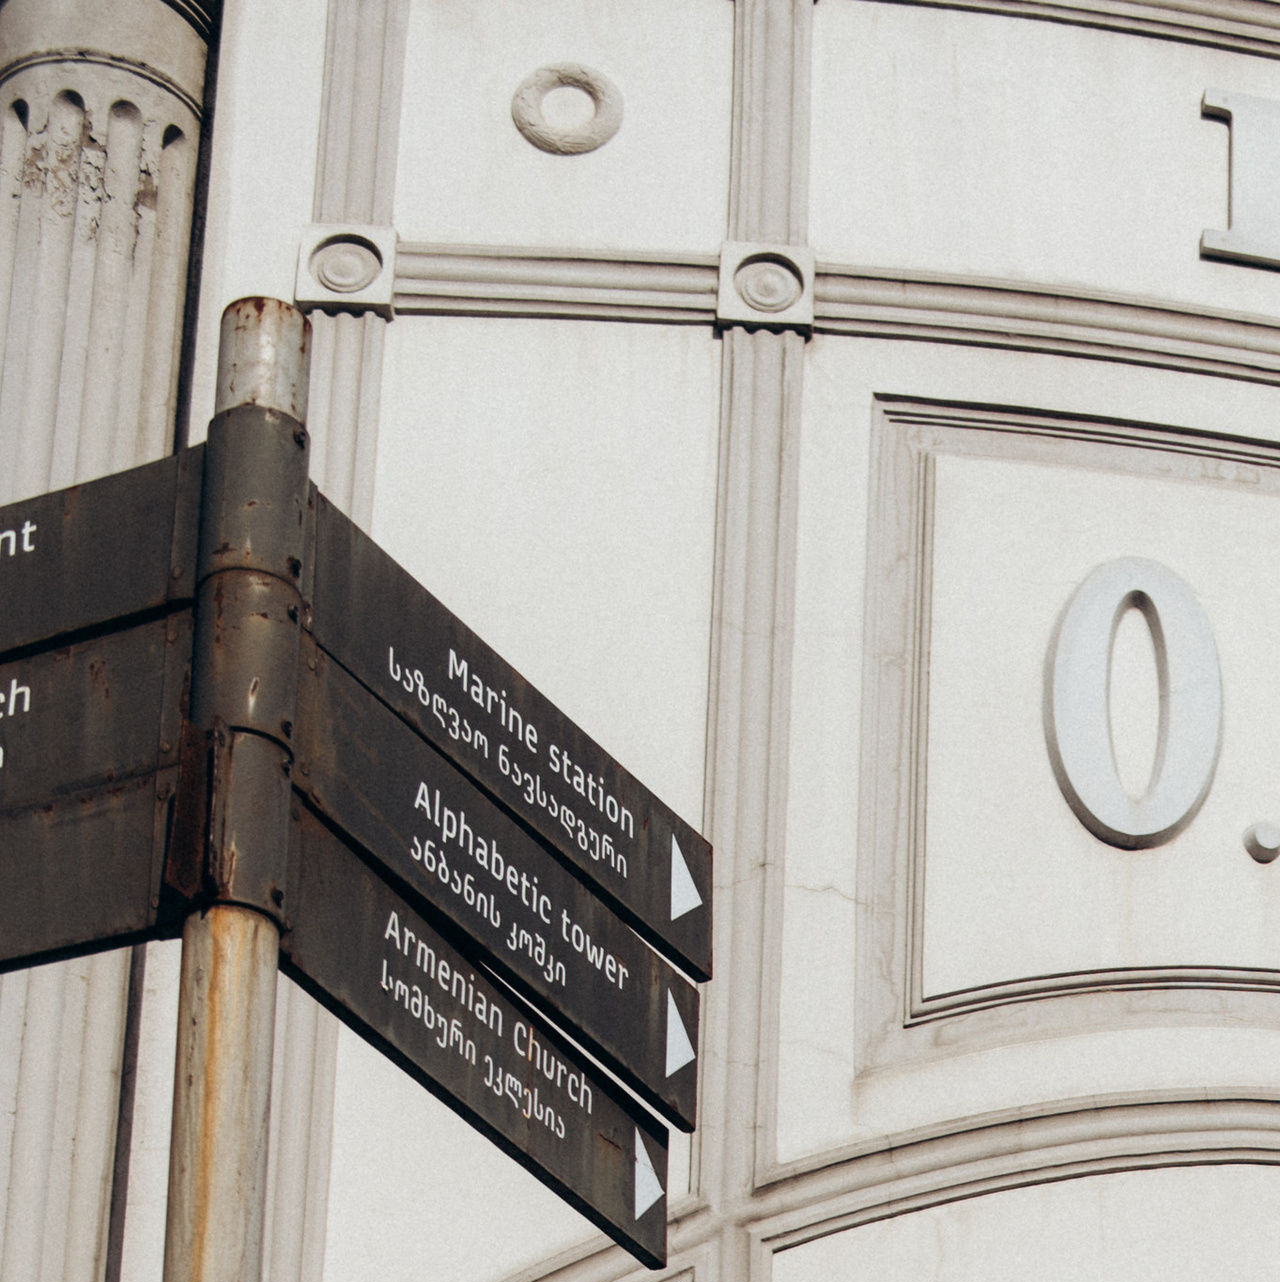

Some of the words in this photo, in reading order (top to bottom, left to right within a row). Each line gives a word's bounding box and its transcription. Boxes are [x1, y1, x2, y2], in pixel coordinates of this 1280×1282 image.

[389, 646, 488, 758] საზღვაო
[498, 744, 628, 878] ნავსადგური
[448, 648, 538, 753] Marine
[549, 745, 634, 839] station
[410, 836, 501, 928] ანბანის
[506, 922, 566, 987] კოშკი
[414, 781, 552, 924] Alphabetic
[561, 909, 629, 990] tower
[380, 959, 476, 1065] სომხური
[484, 1055, 566, 1139] ეკლესია
[384, 911, 503, 1037] Armenian
[514, 1021, 592, 1115] Church
